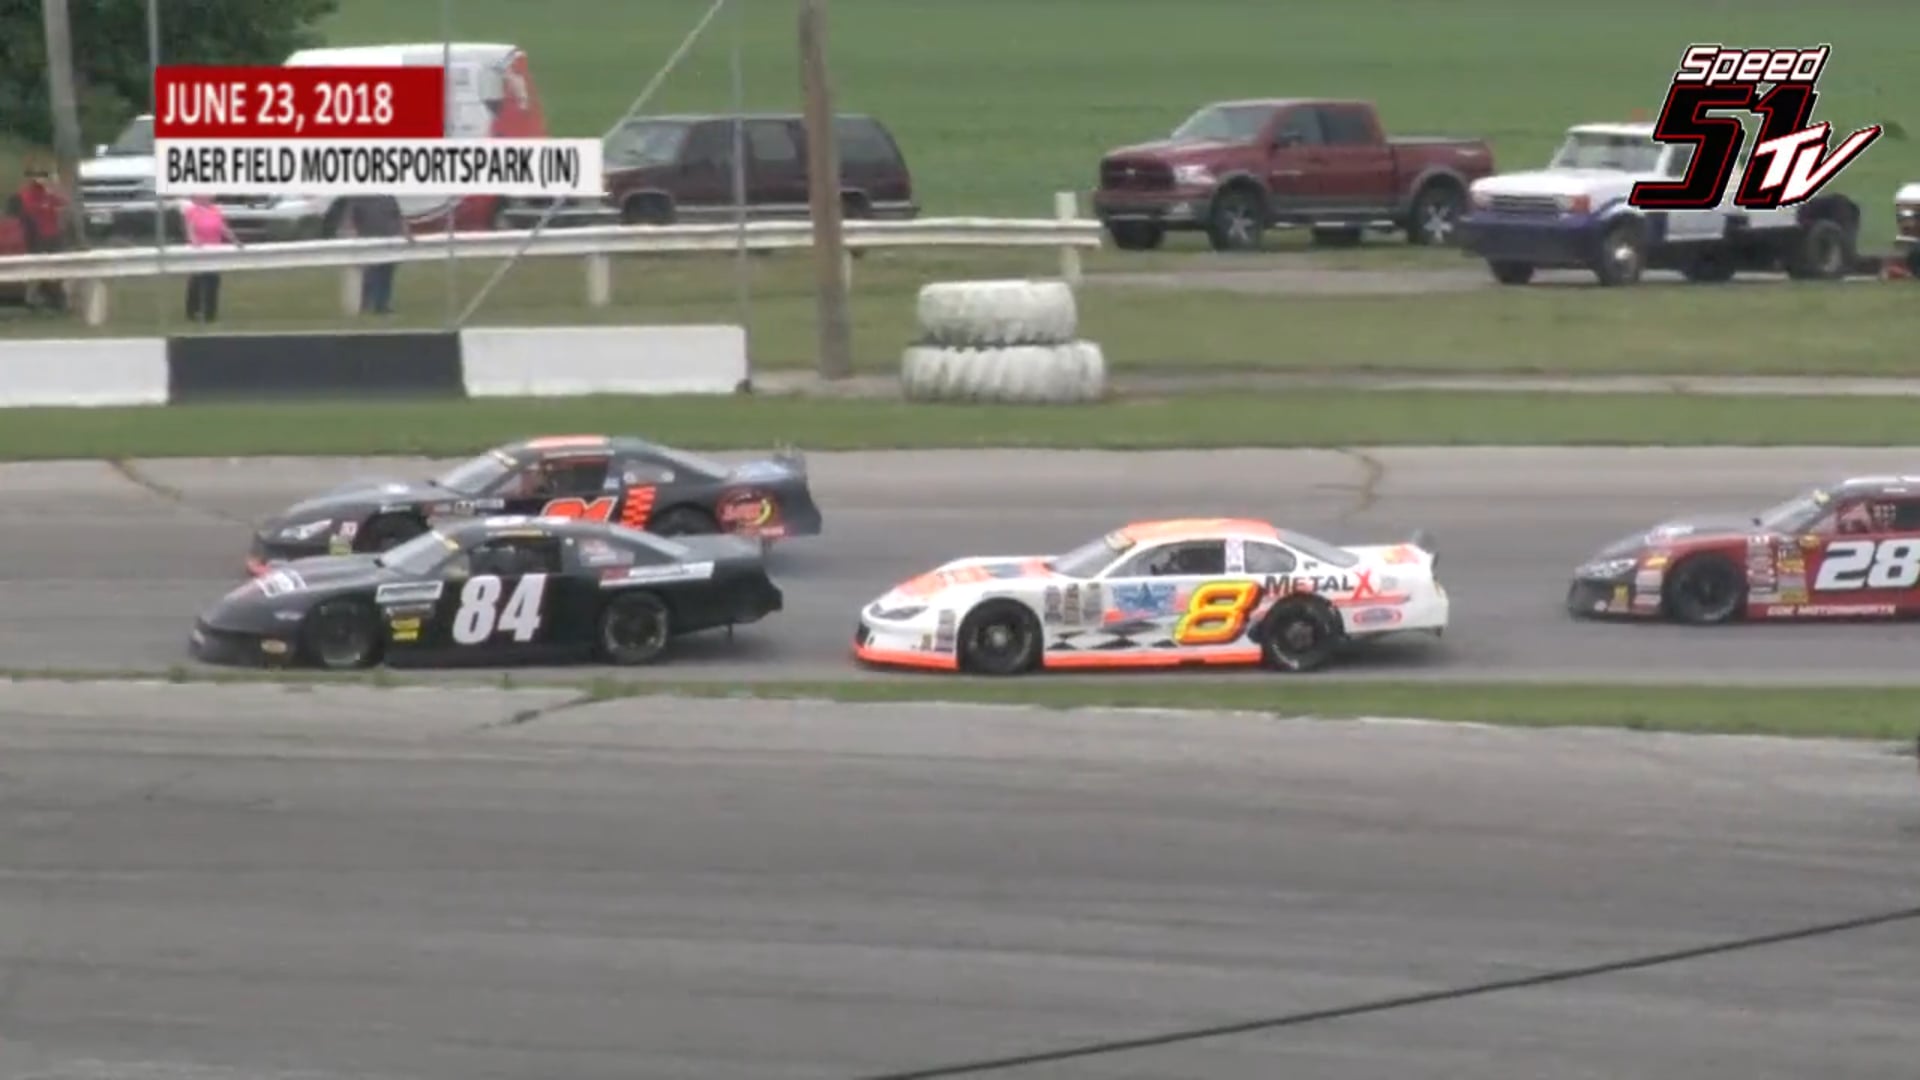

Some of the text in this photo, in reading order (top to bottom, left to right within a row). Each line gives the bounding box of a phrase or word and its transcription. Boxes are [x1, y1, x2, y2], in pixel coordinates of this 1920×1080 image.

[1263, 569, 1376, 600] METALX
[1814, 539, 1920, 590] 28
[452, 573, 549, 644] 84
[1174, 580, 1260, 645] 8
